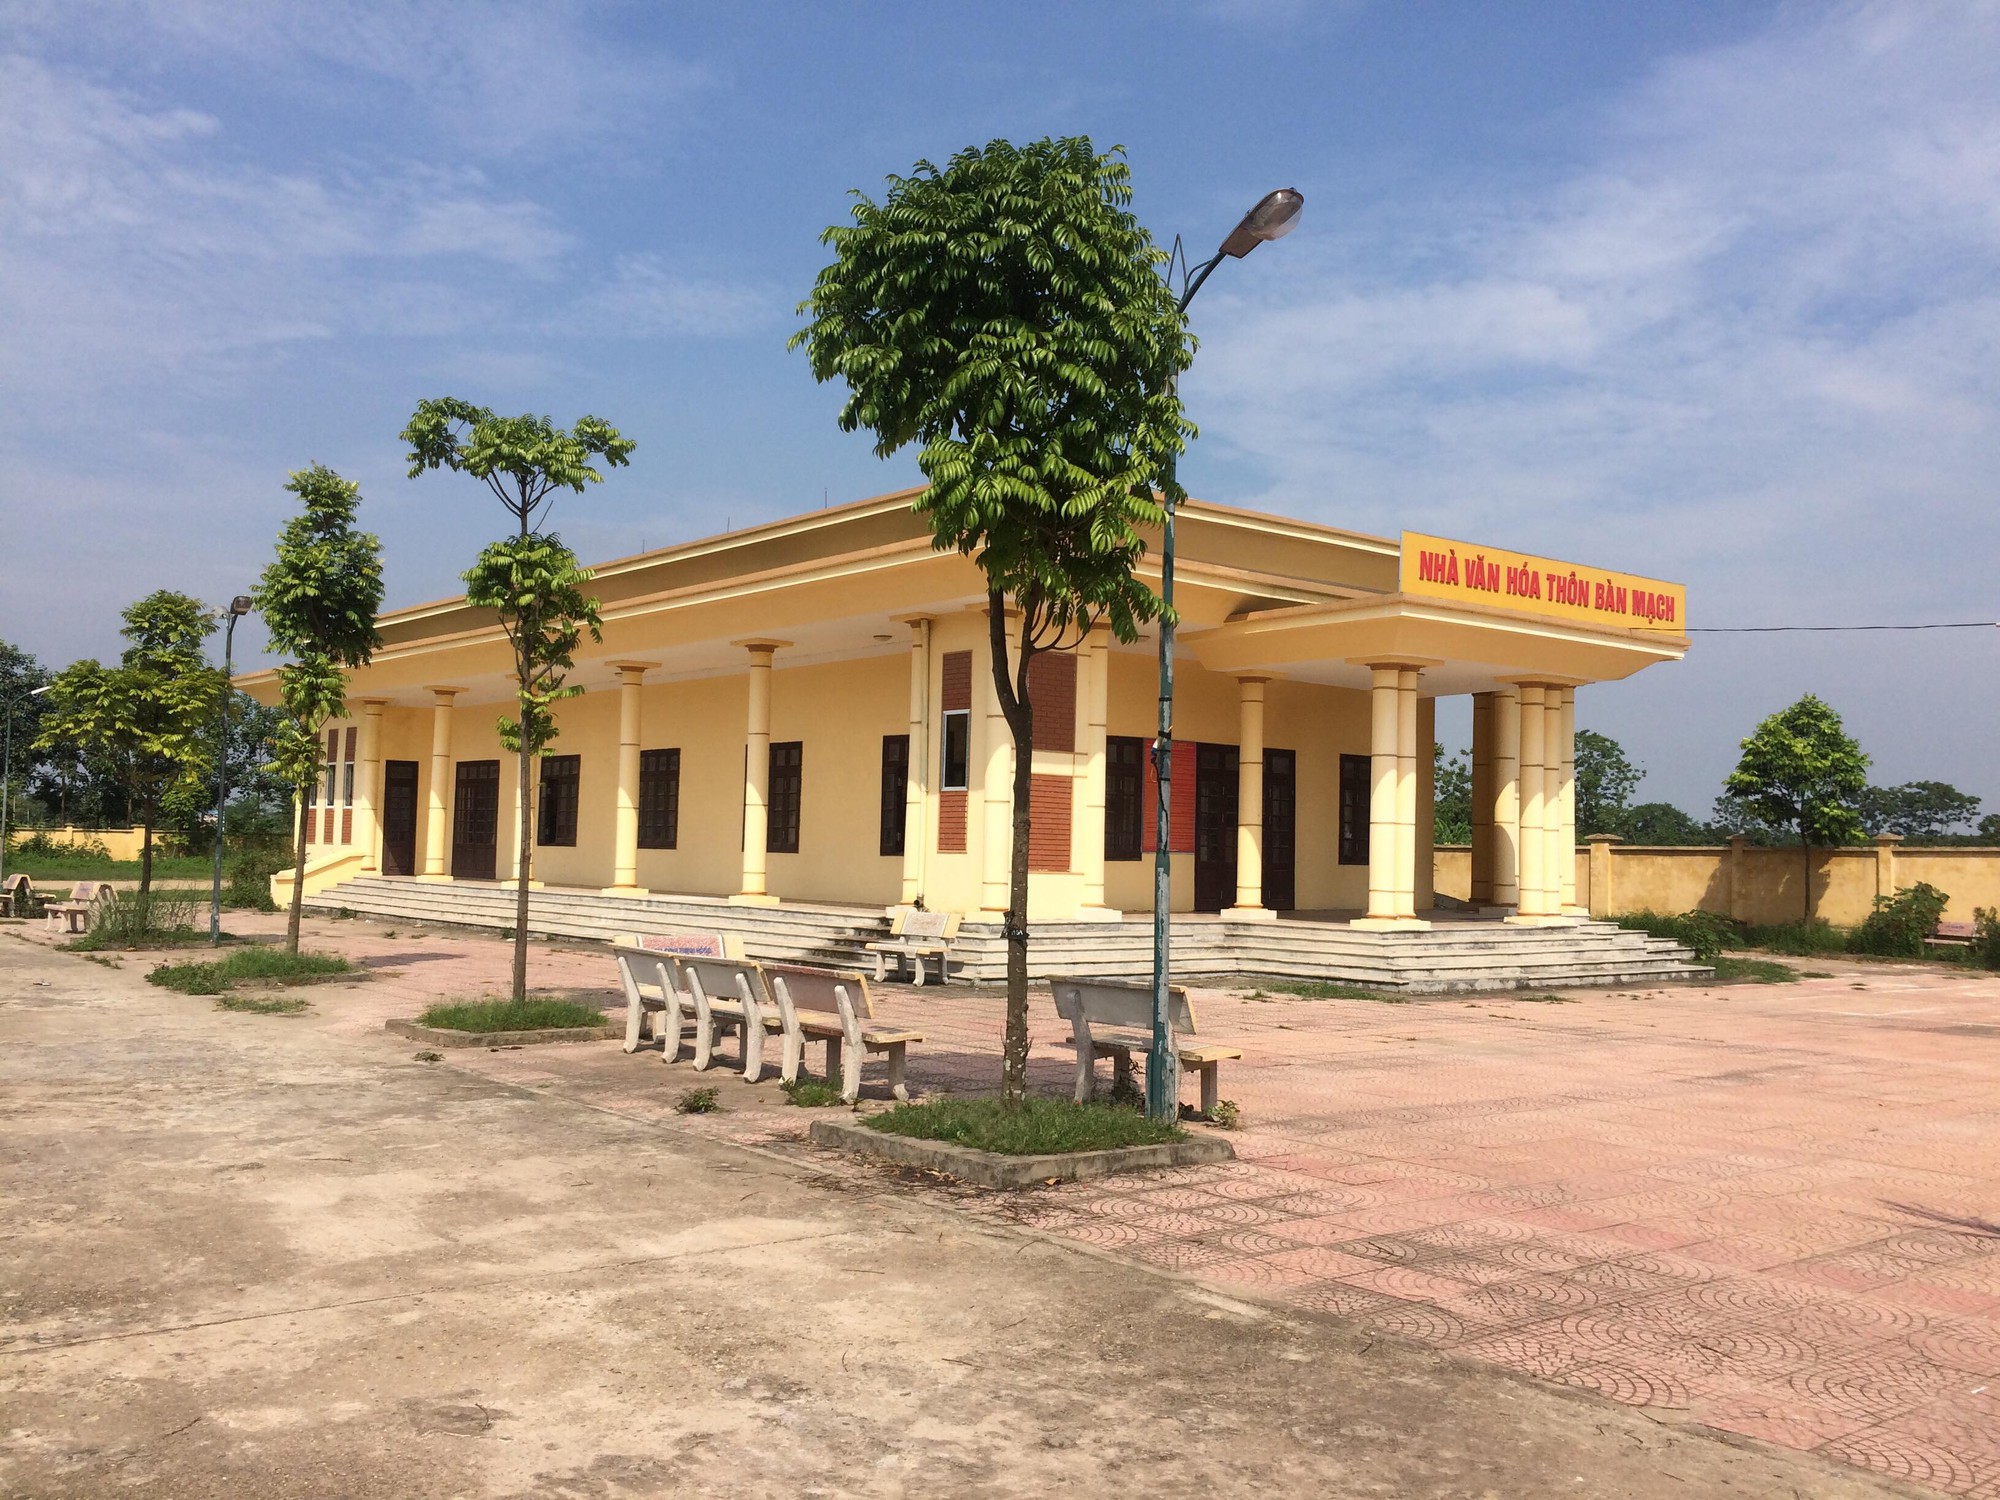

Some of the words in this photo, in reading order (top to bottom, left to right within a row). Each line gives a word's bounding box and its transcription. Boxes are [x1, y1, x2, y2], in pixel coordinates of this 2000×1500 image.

[1419, 549, 1459, 585] NHÀ
[1465, 555, 1500, 592] VĂN
[1506, 562, 1541, 600] HÓA
[1546, 571, 1590, 608] THÔN
[1594, 579, 1627, 614] BÀN
[1631, 589, 1675, 624] MẠCH
